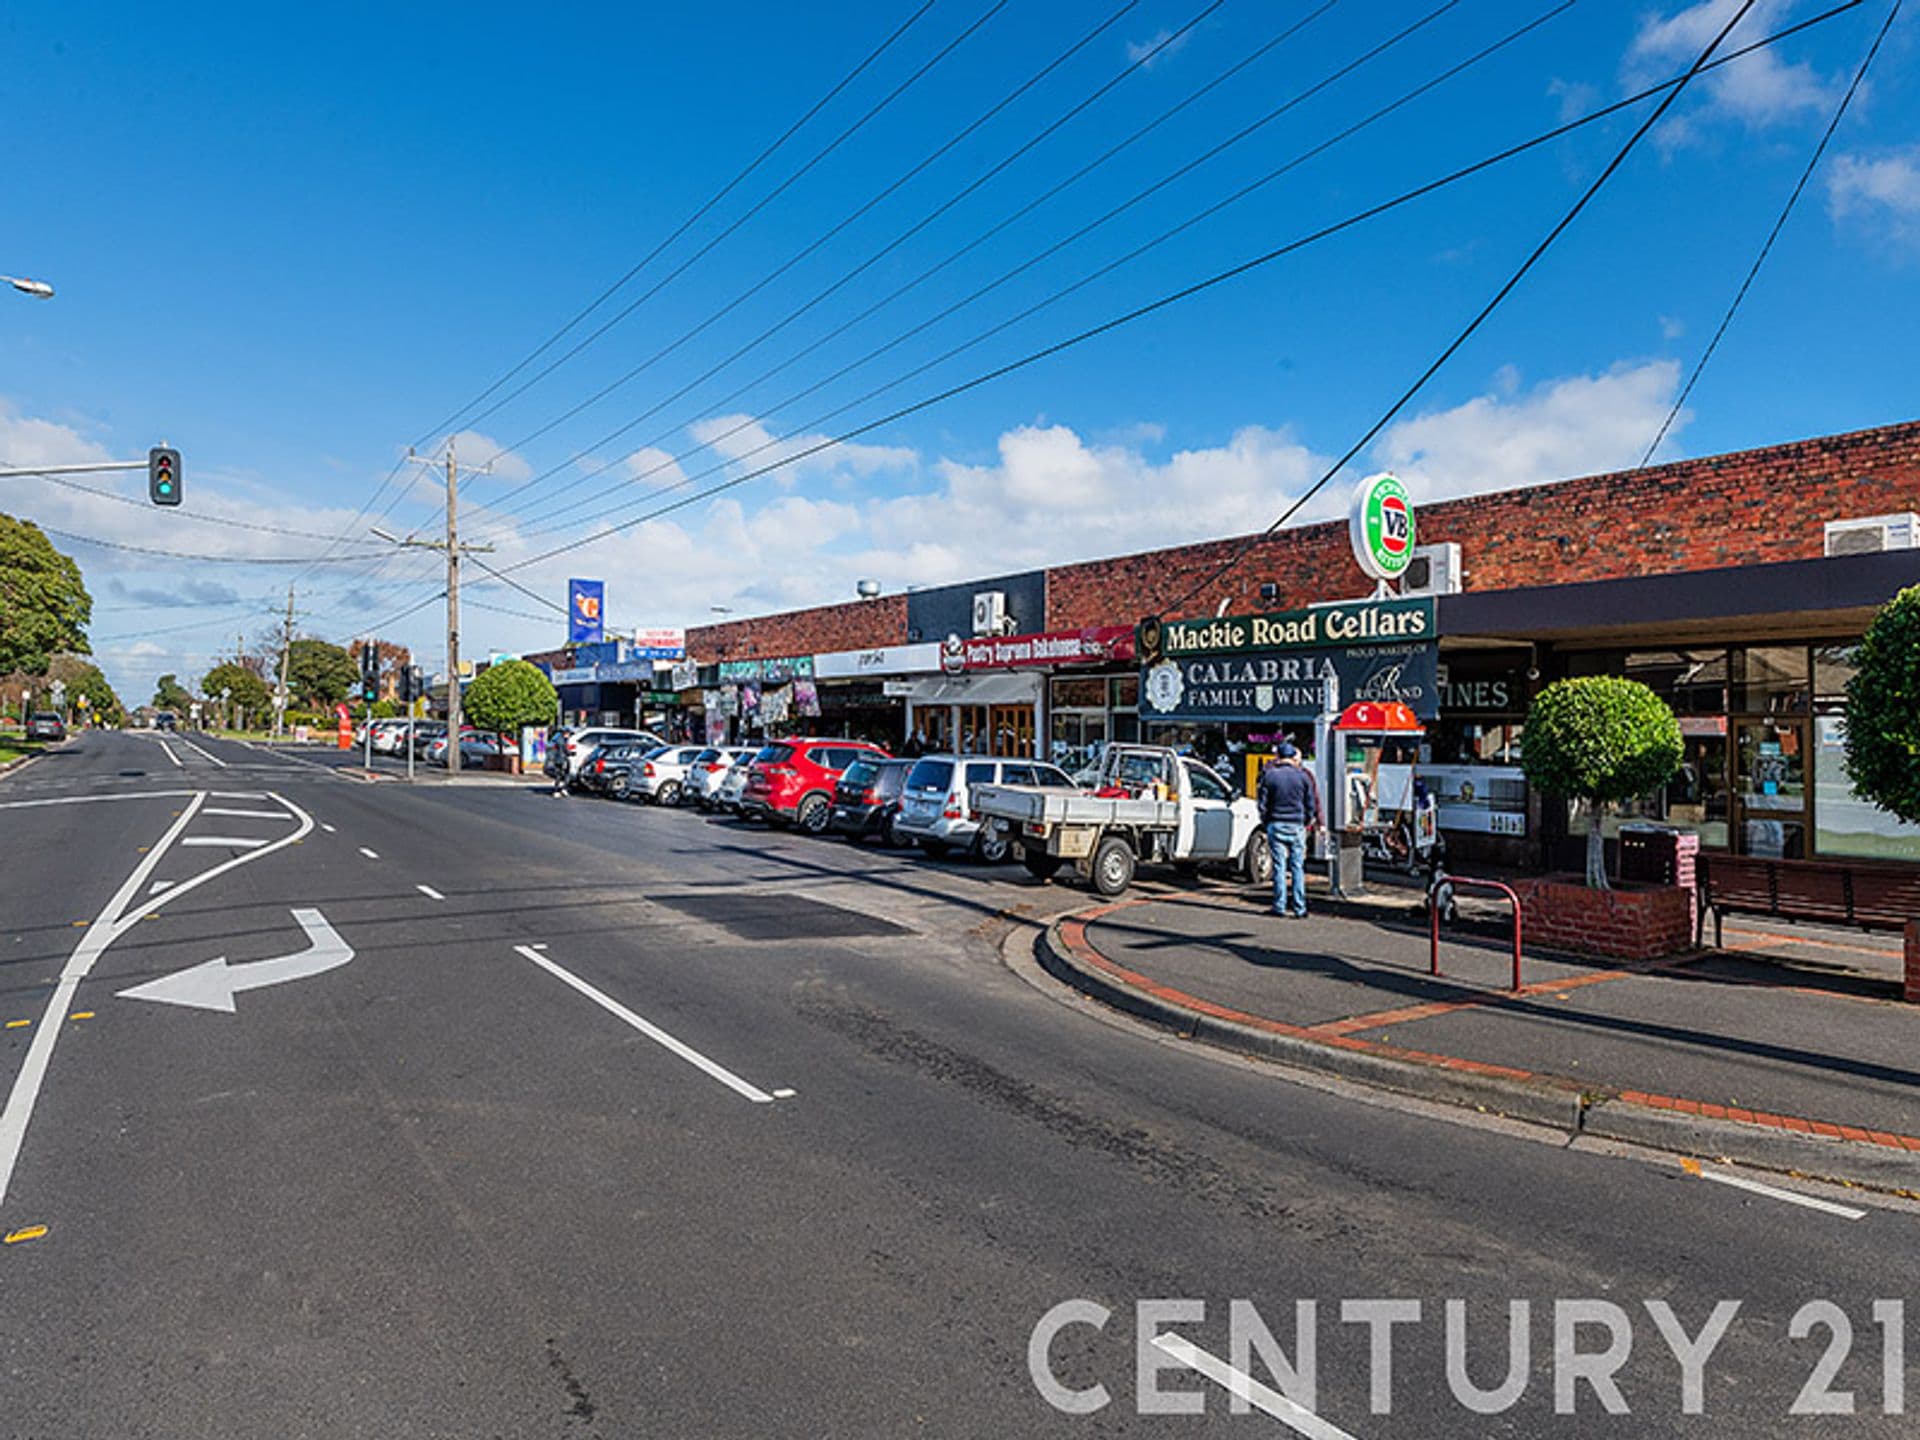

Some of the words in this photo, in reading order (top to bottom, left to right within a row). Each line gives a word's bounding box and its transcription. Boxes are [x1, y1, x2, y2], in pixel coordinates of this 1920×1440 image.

[1383, 509, 1408, 538] VB
[1166, 621, 1245, 651] Mackie
[1252, 614, 1316, 645] Road
[1325, 606, 1425, 640] Cellars
[1188, 657, 1338, 685] CALABRIA
[1188, 688, 1253, 707] FAMILY
